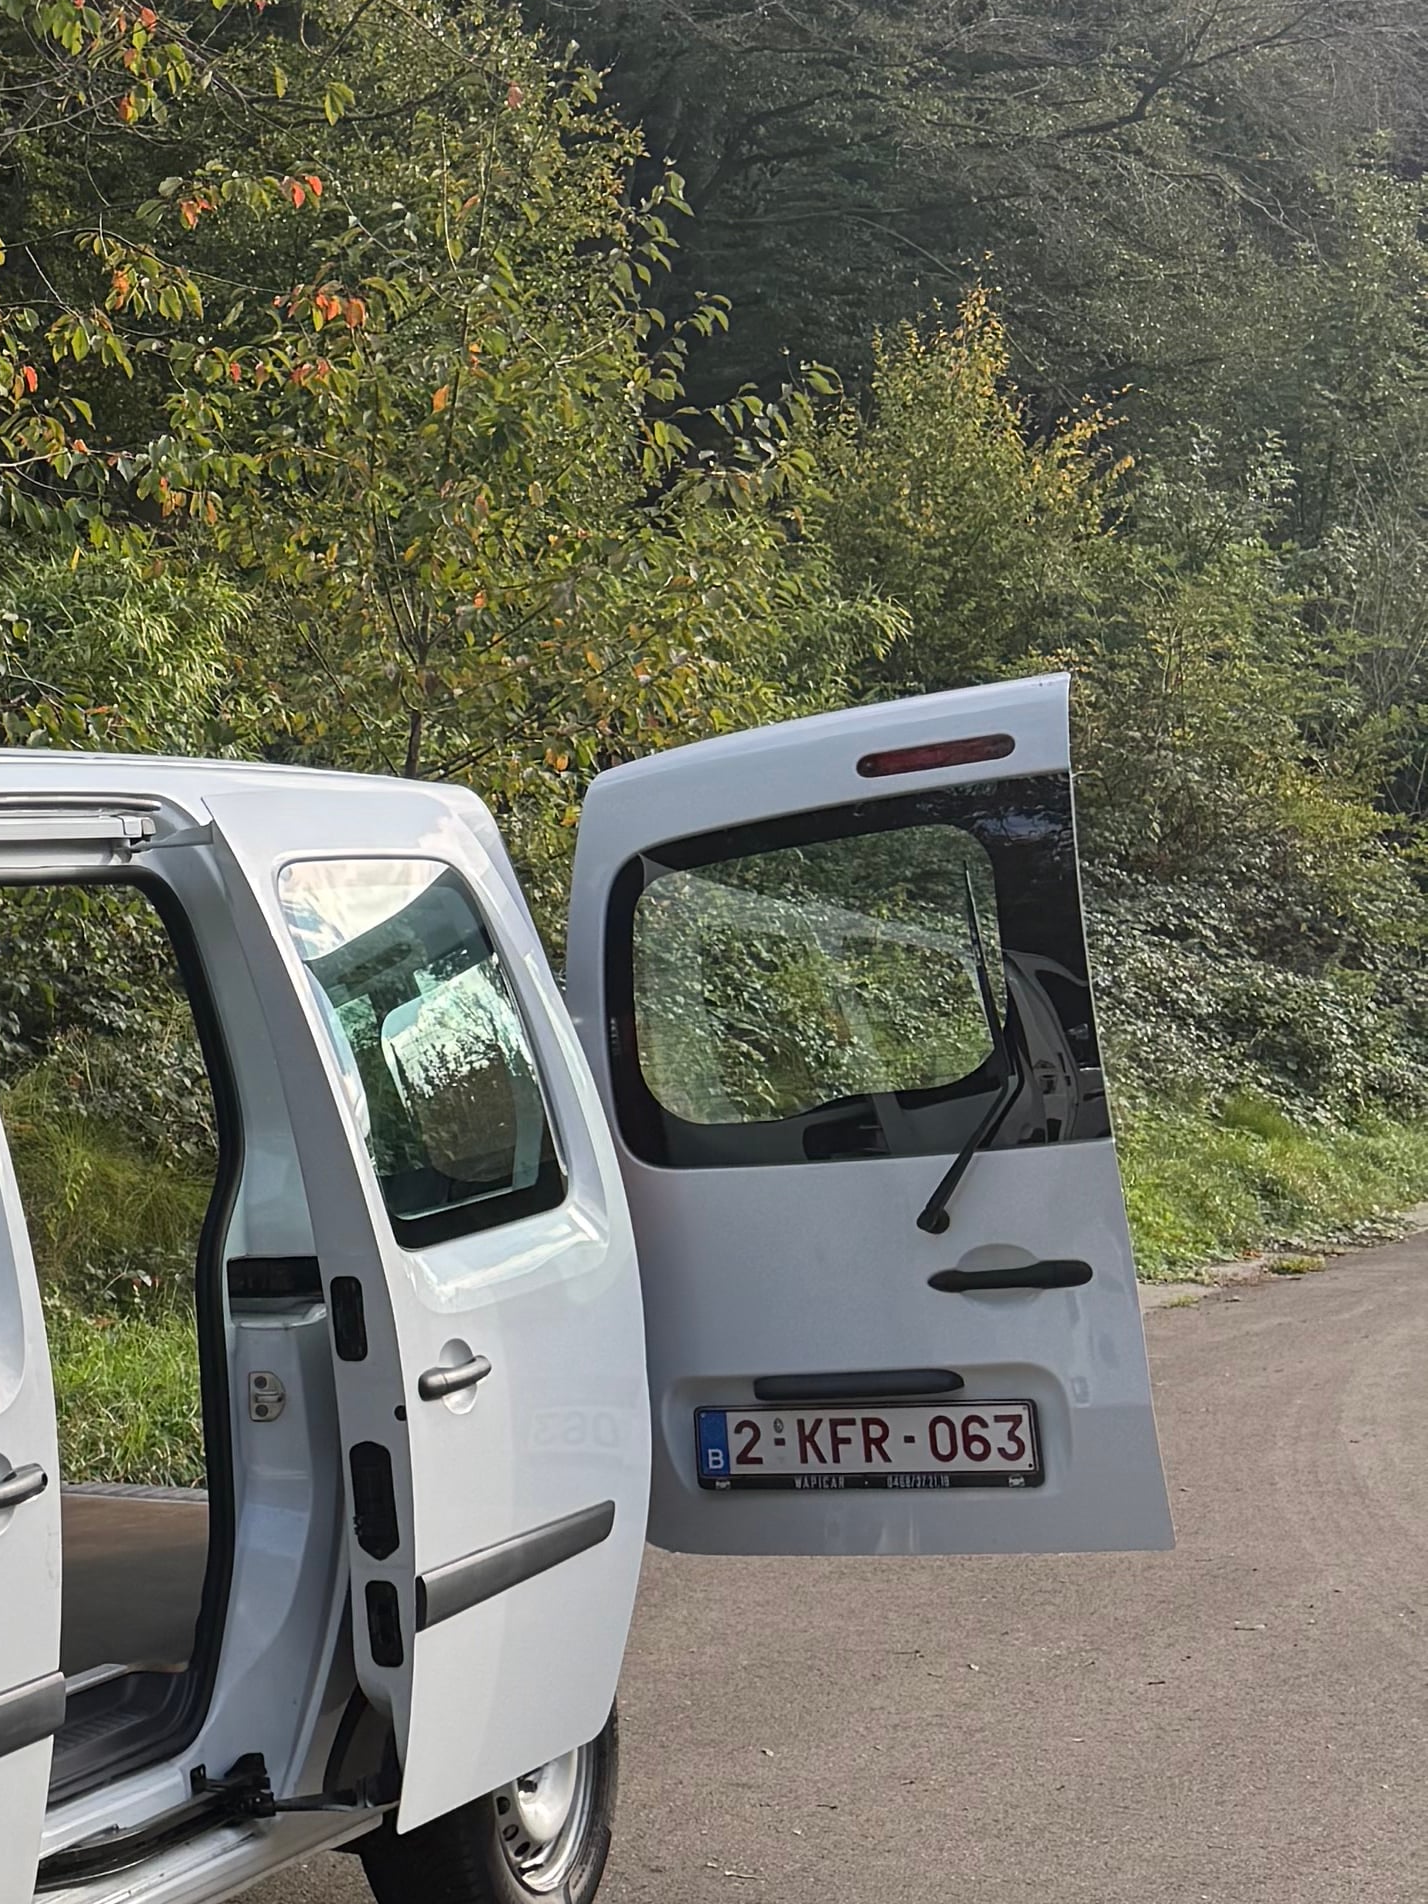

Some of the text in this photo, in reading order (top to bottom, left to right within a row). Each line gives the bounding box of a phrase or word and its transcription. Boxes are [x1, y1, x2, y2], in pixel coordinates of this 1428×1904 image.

[708, 1414, 1026, 1470] B 2-KFR-063
[794, 1474, 844, 1489] WAPICAR
